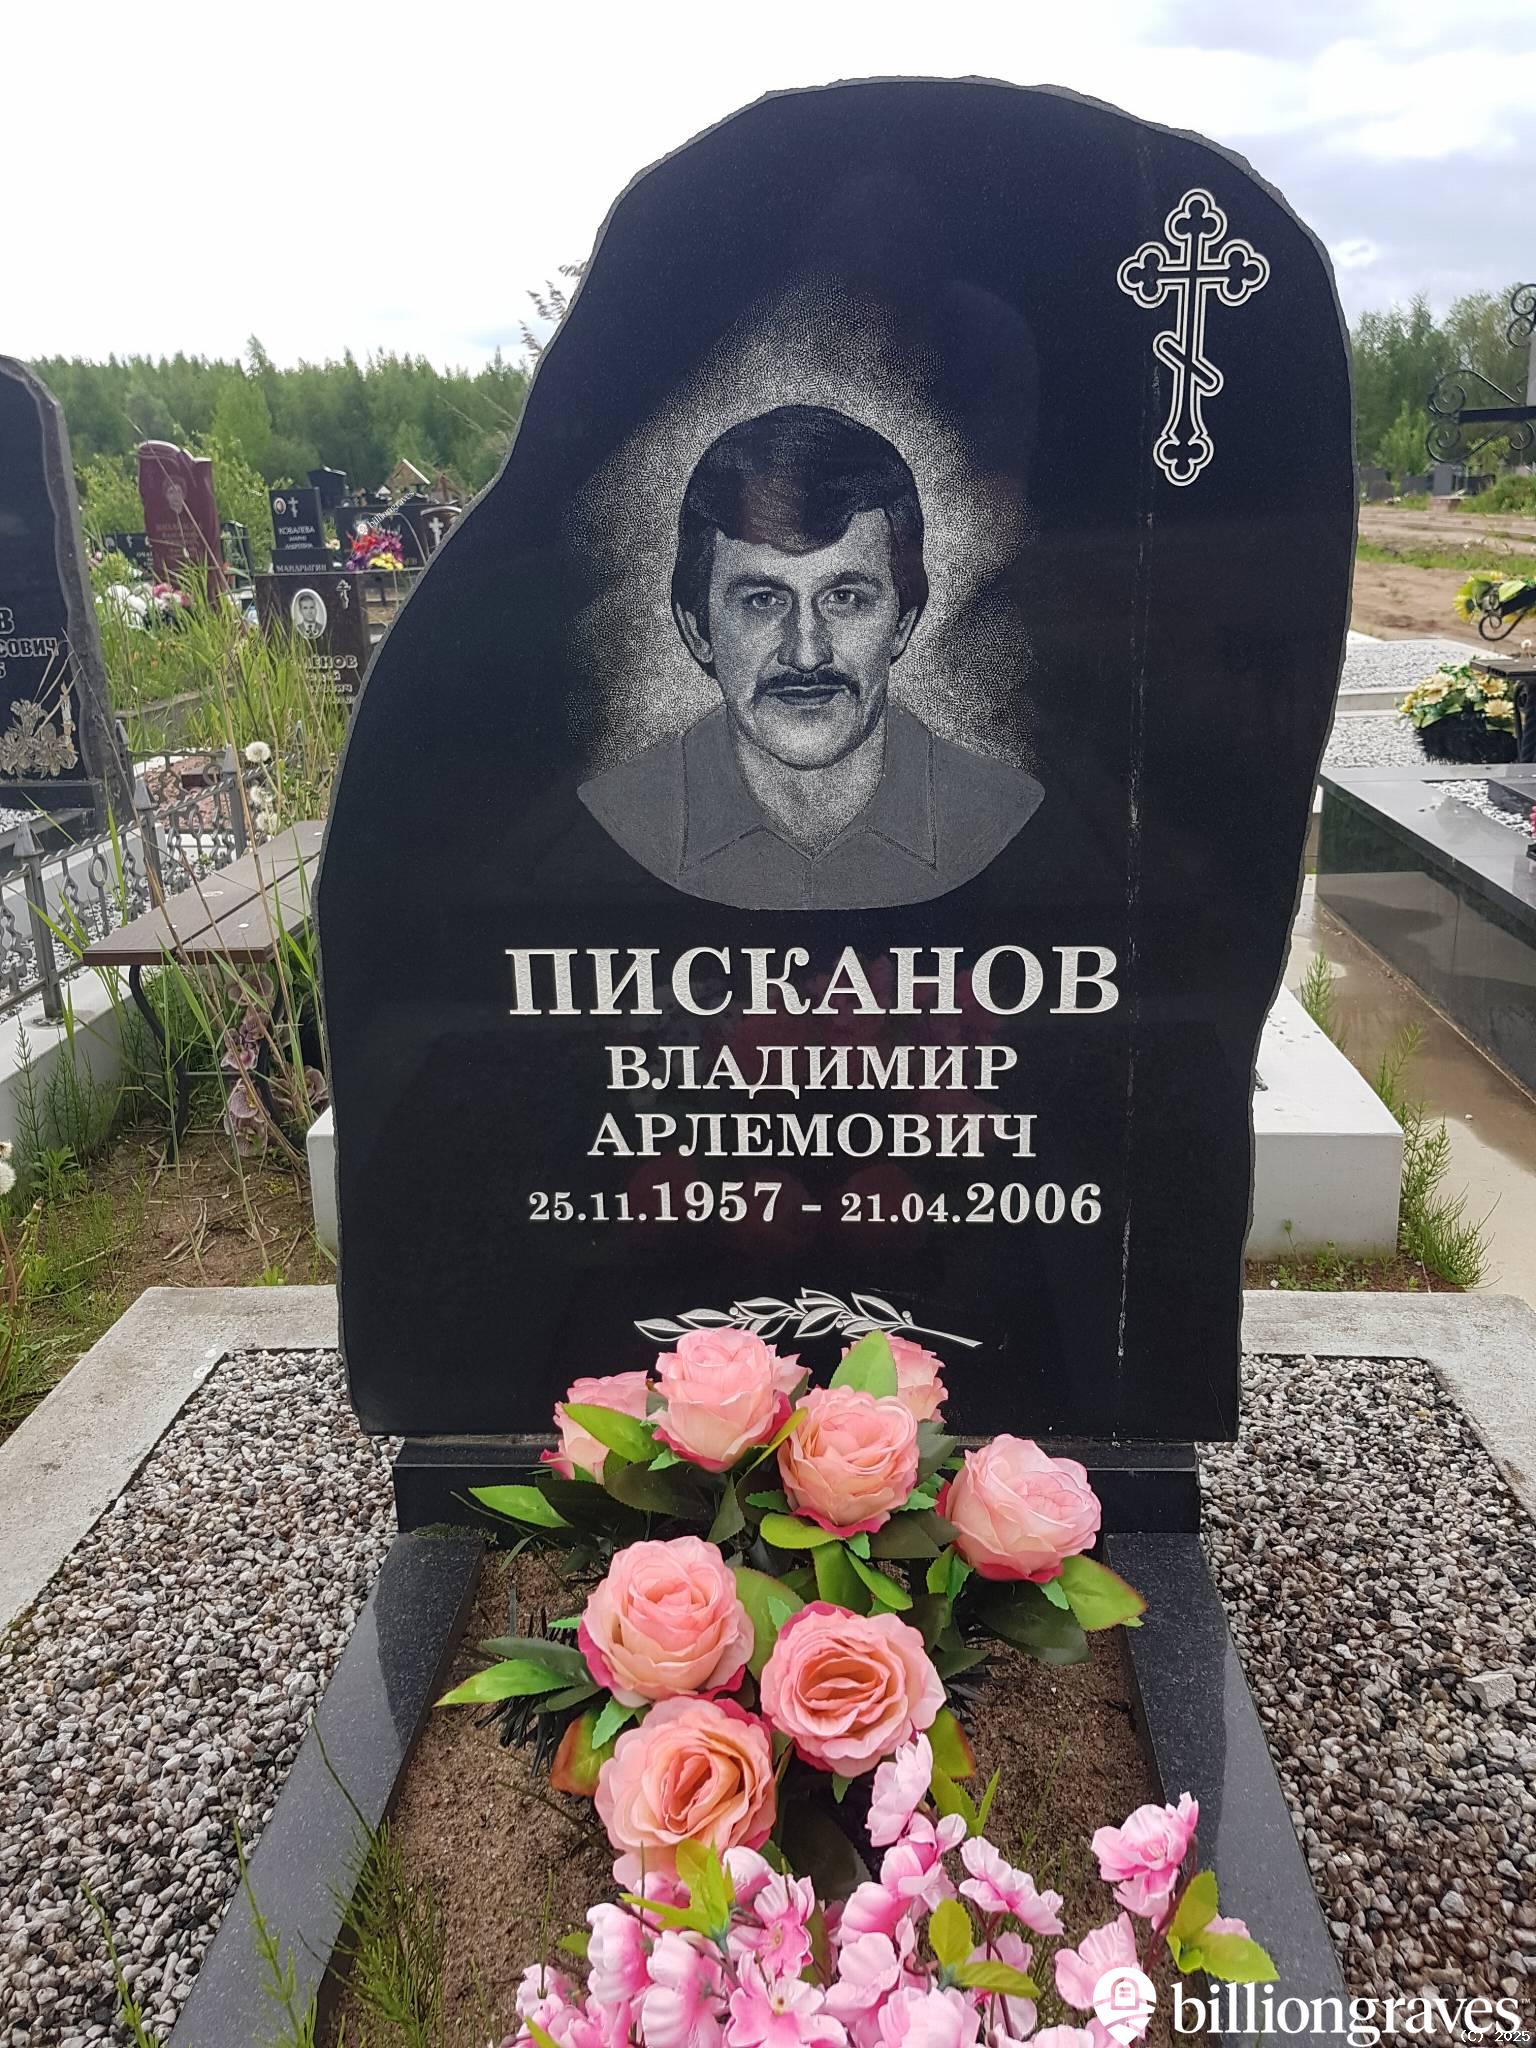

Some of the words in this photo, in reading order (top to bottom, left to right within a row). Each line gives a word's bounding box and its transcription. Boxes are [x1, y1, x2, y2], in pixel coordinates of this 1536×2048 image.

[278, 526, 316, 535] КОВАЛЕВА
[505, 945, 1120, 1016] ПИСКАНОВ
[605, 1045, 1018, 1099] ВЛАДИМИР
[587, 1113, 1038, 1157] АРЛЕМОВИЧ
[528, 1181, 783, 1222] 25.11.1957
[840, 1182, 1102, 1224] 21.04.2006
